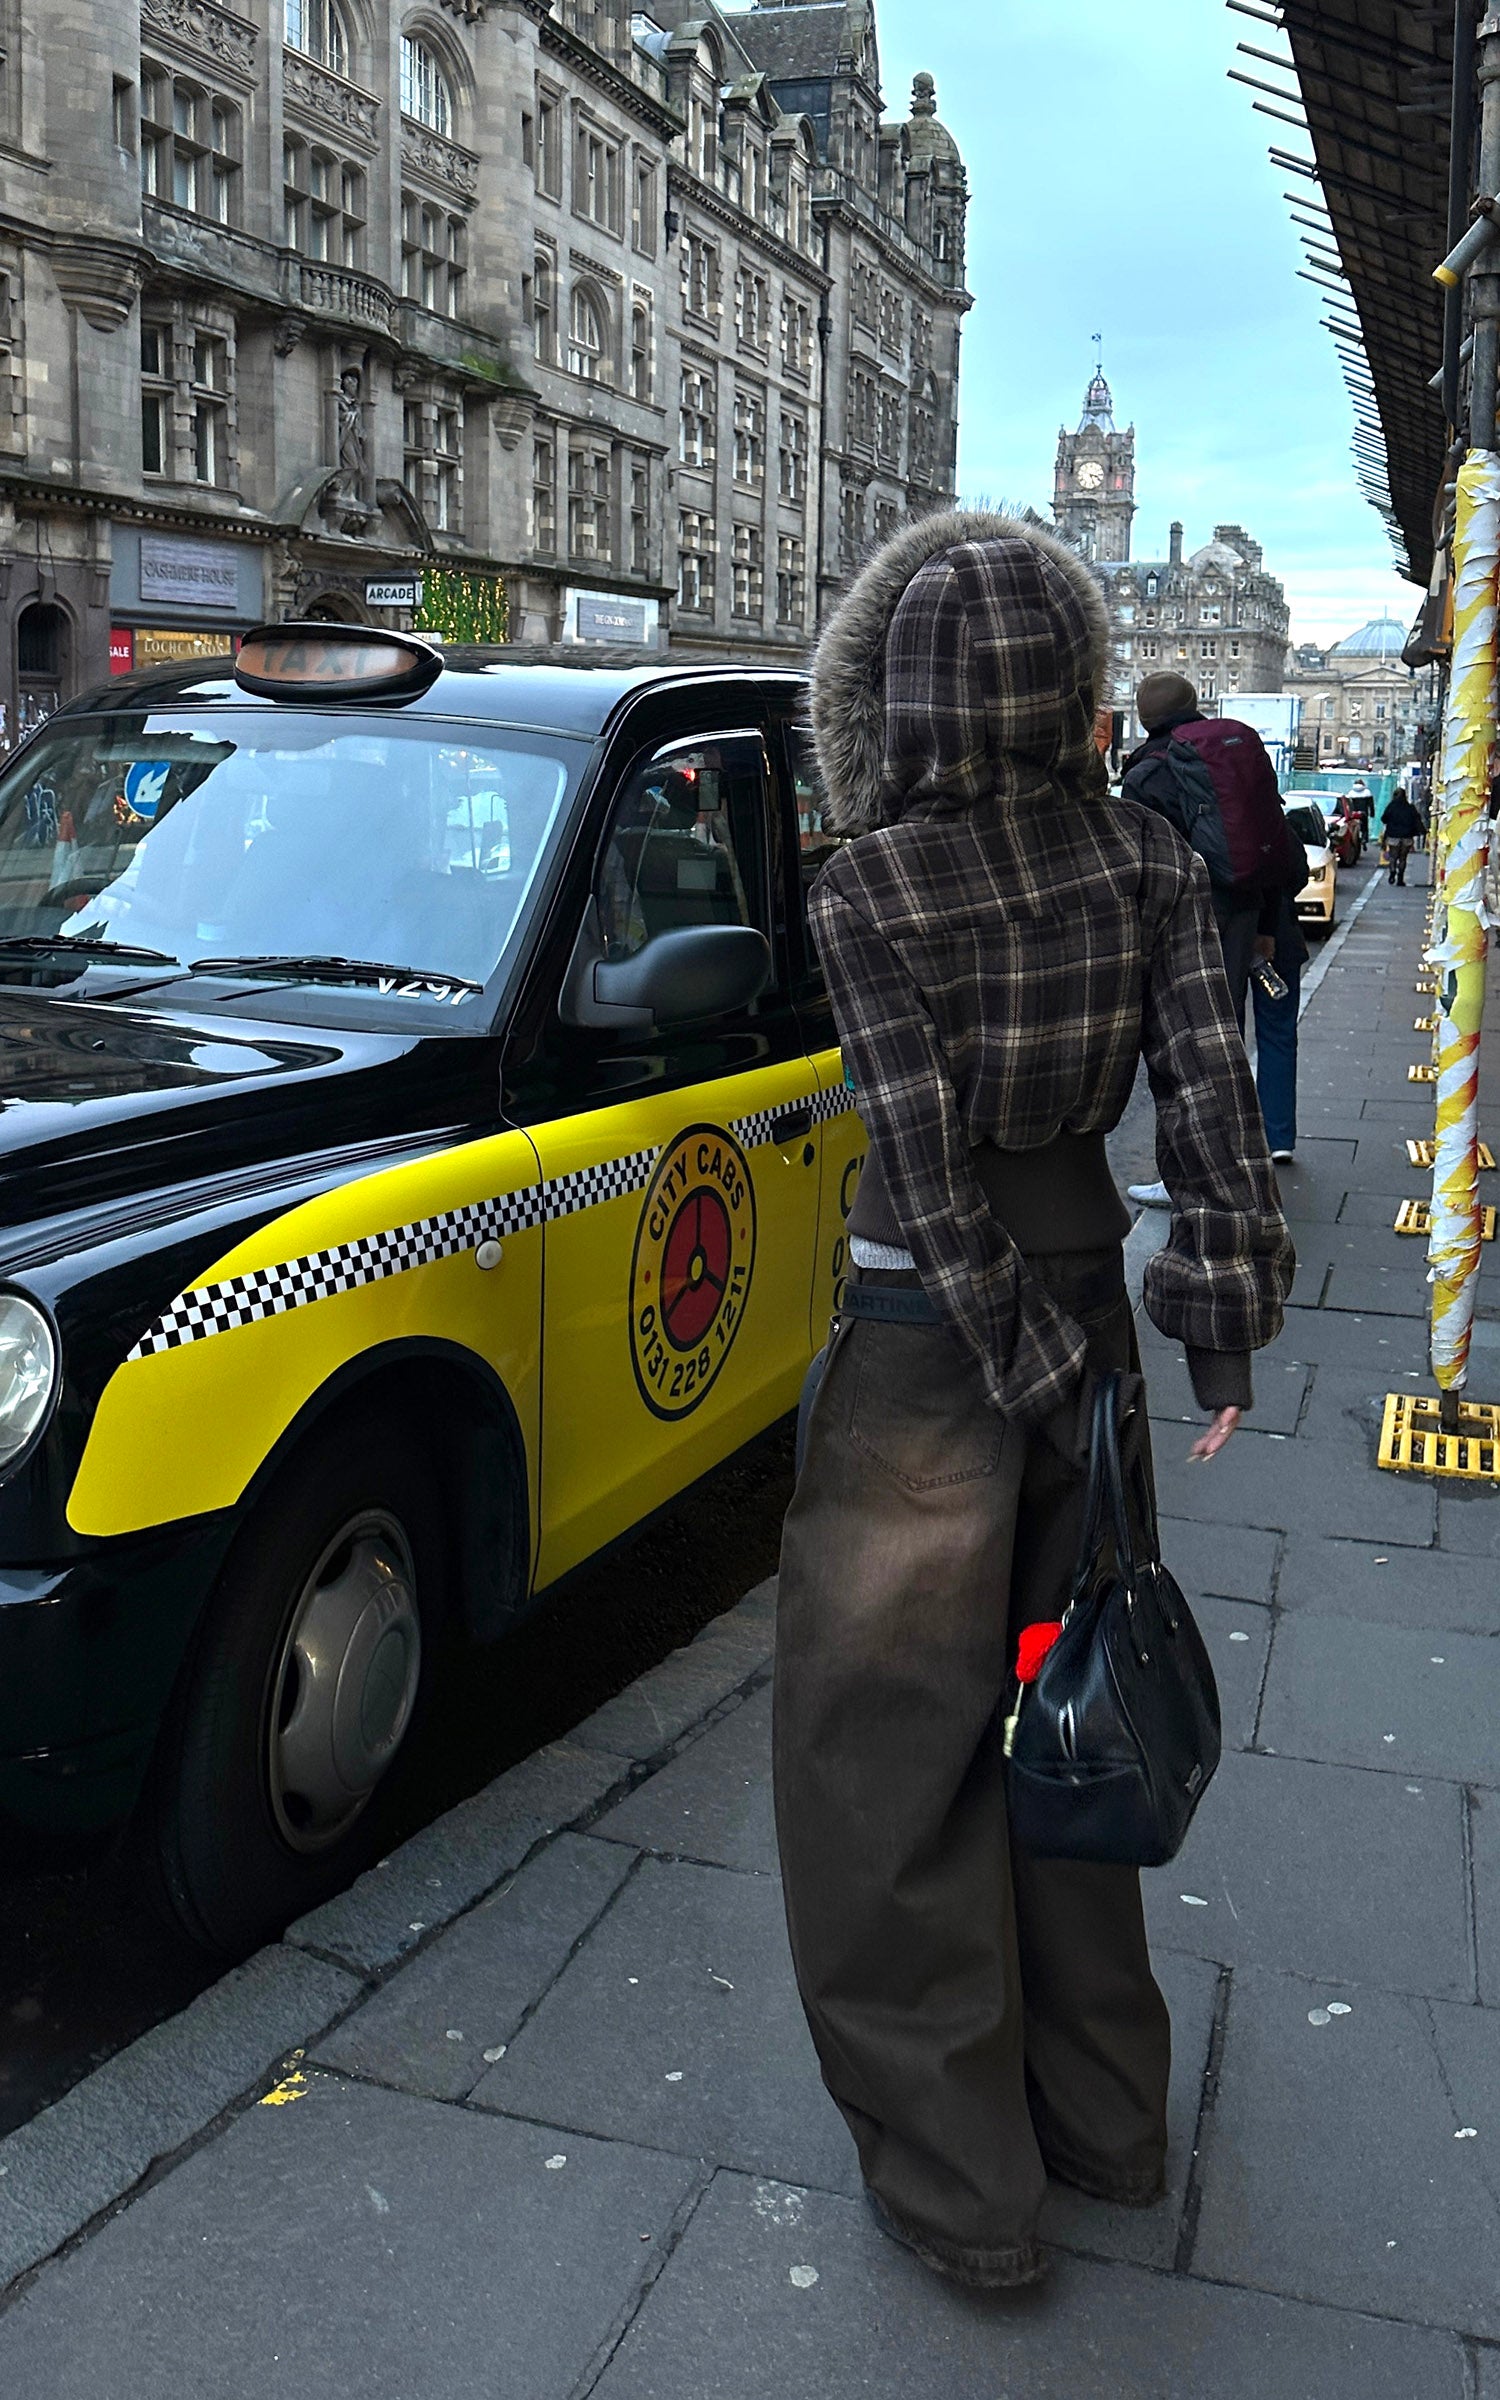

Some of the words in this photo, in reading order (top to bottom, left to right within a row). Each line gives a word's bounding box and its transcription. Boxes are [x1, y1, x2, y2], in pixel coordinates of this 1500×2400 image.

[143, 561, 200, 582] CASHMERE
[201, 567, 235, 586] HOUSE
[368, 587, 414, 599] ARCADE
[144, 640, 225, 656] LOCHCARRON
[262, 641, 372, 675] TAXI
[649, 1153, 690, 1242] CITY
[697, 1142, 745, 1211] CABS
[639, 1303, 670, 1390] 0131
[669, 1345, 711, 1398] 228
[715, 1265, 746, 1347] 1211
